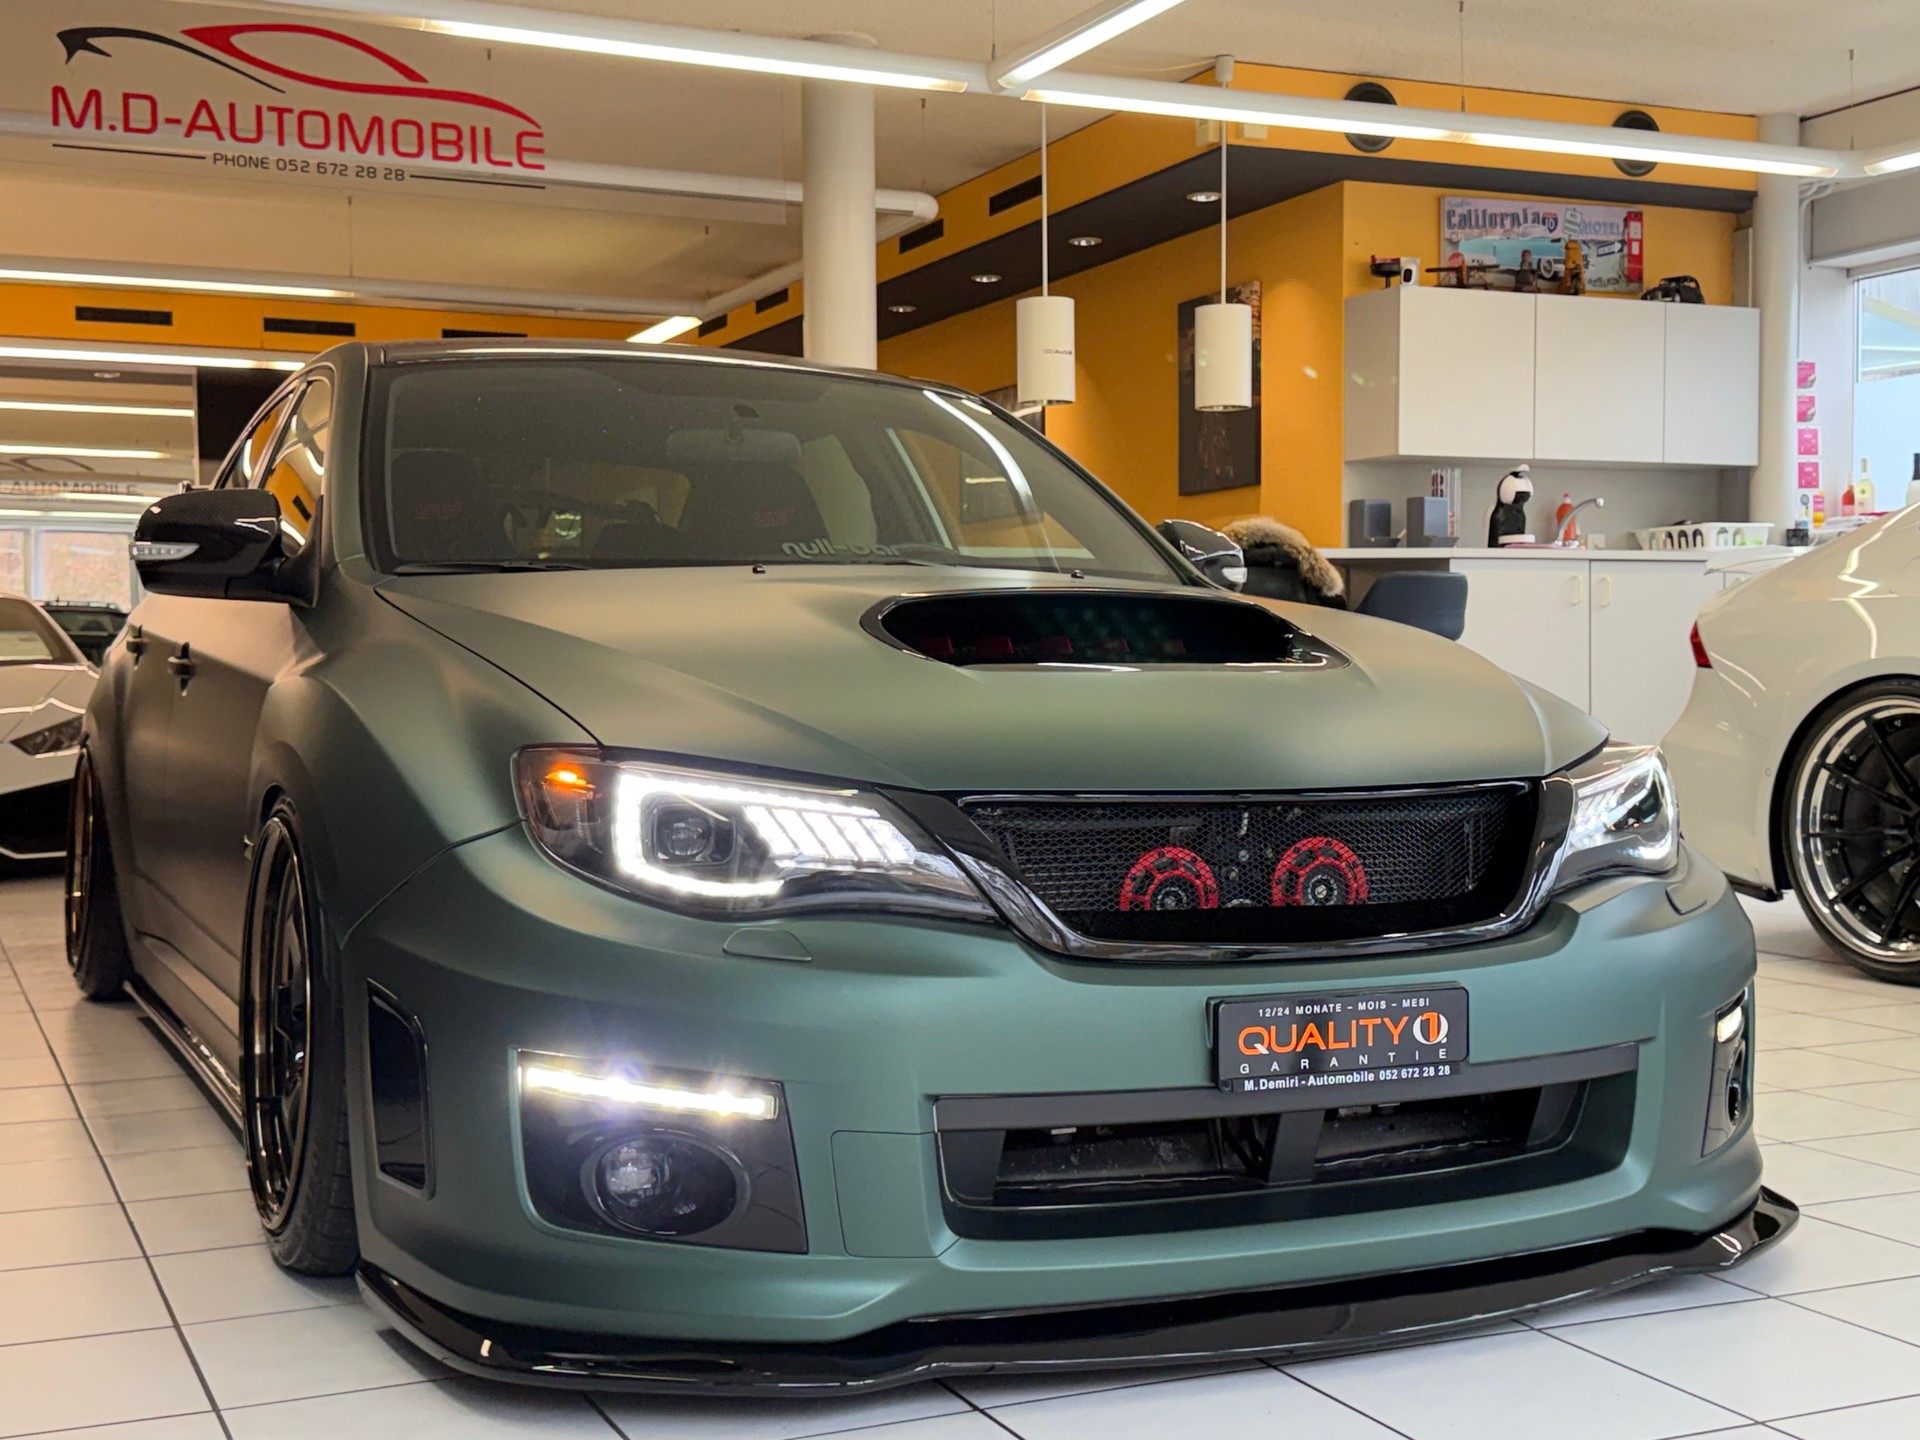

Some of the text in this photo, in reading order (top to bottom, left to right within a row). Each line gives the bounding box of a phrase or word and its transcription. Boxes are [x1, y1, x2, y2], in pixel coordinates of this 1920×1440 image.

[52, 84, 545, 170] M.D-AUTOMOBILE
[213, 152, 405, 181] PHONE 052 672 28 28
[1446, 207, 1540, 230] California
[1258, 1007, 1290, 1018] 12/24
[1295, 1003, 1342, 1015] MONATE
[1358, 1000, 1387, 1011] MOIS
[1402, 998, 1430, 1008] MESI
[1238, 1016, 1409, 1056] QUALITY
[1239, 1048, 1447, 1074] GARANTIE
[1379, 1069, 1398, 1081] 052
[1401, 1067, 1419, 1079] 672
[1423, 1066, 1435, 1077] 28
[1438, 1065, 1450, 1076] 28
